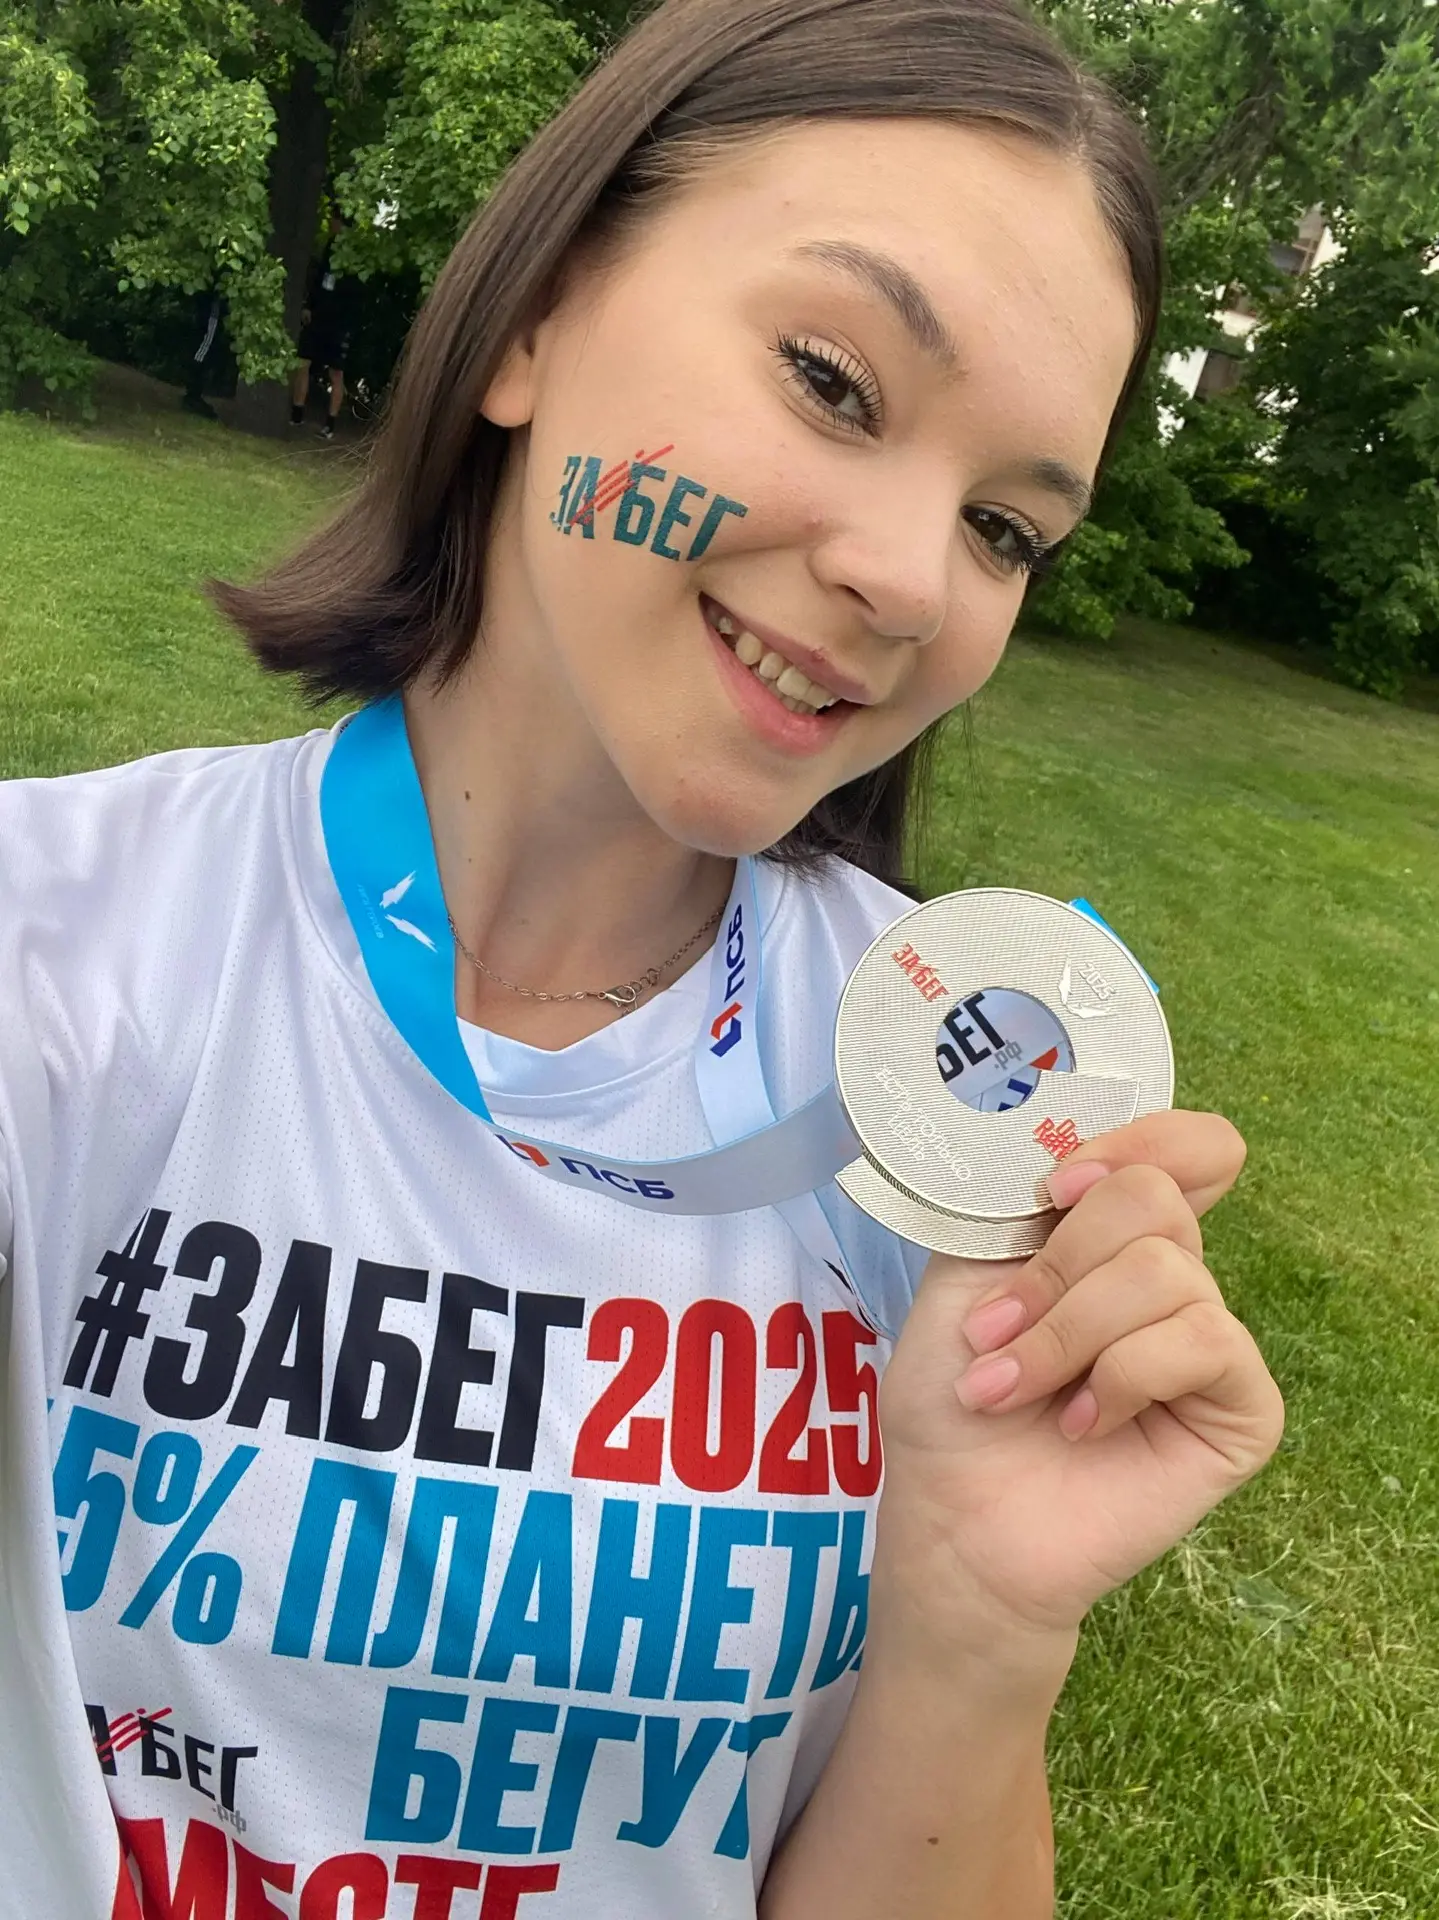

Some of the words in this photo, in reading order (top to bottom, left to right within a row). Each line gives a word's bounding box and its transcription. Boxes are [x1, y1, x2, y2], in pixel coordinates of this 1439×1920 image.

[549, 445, 748, 562] ЗАБЕГ
[724, 903, 746, 1003] ПСБ
[890, 940, 950, 1003] ЗАБЕГ
[1077, 960, 1116, 1001] 2025
[558, 1156, 676, 1200] ПСБ
[47, 1397, 262, 1645] 5%
[84, 1703, 259, 1813] АБЕГ
[364, 1686, 793, 1860] БЕГУТ
